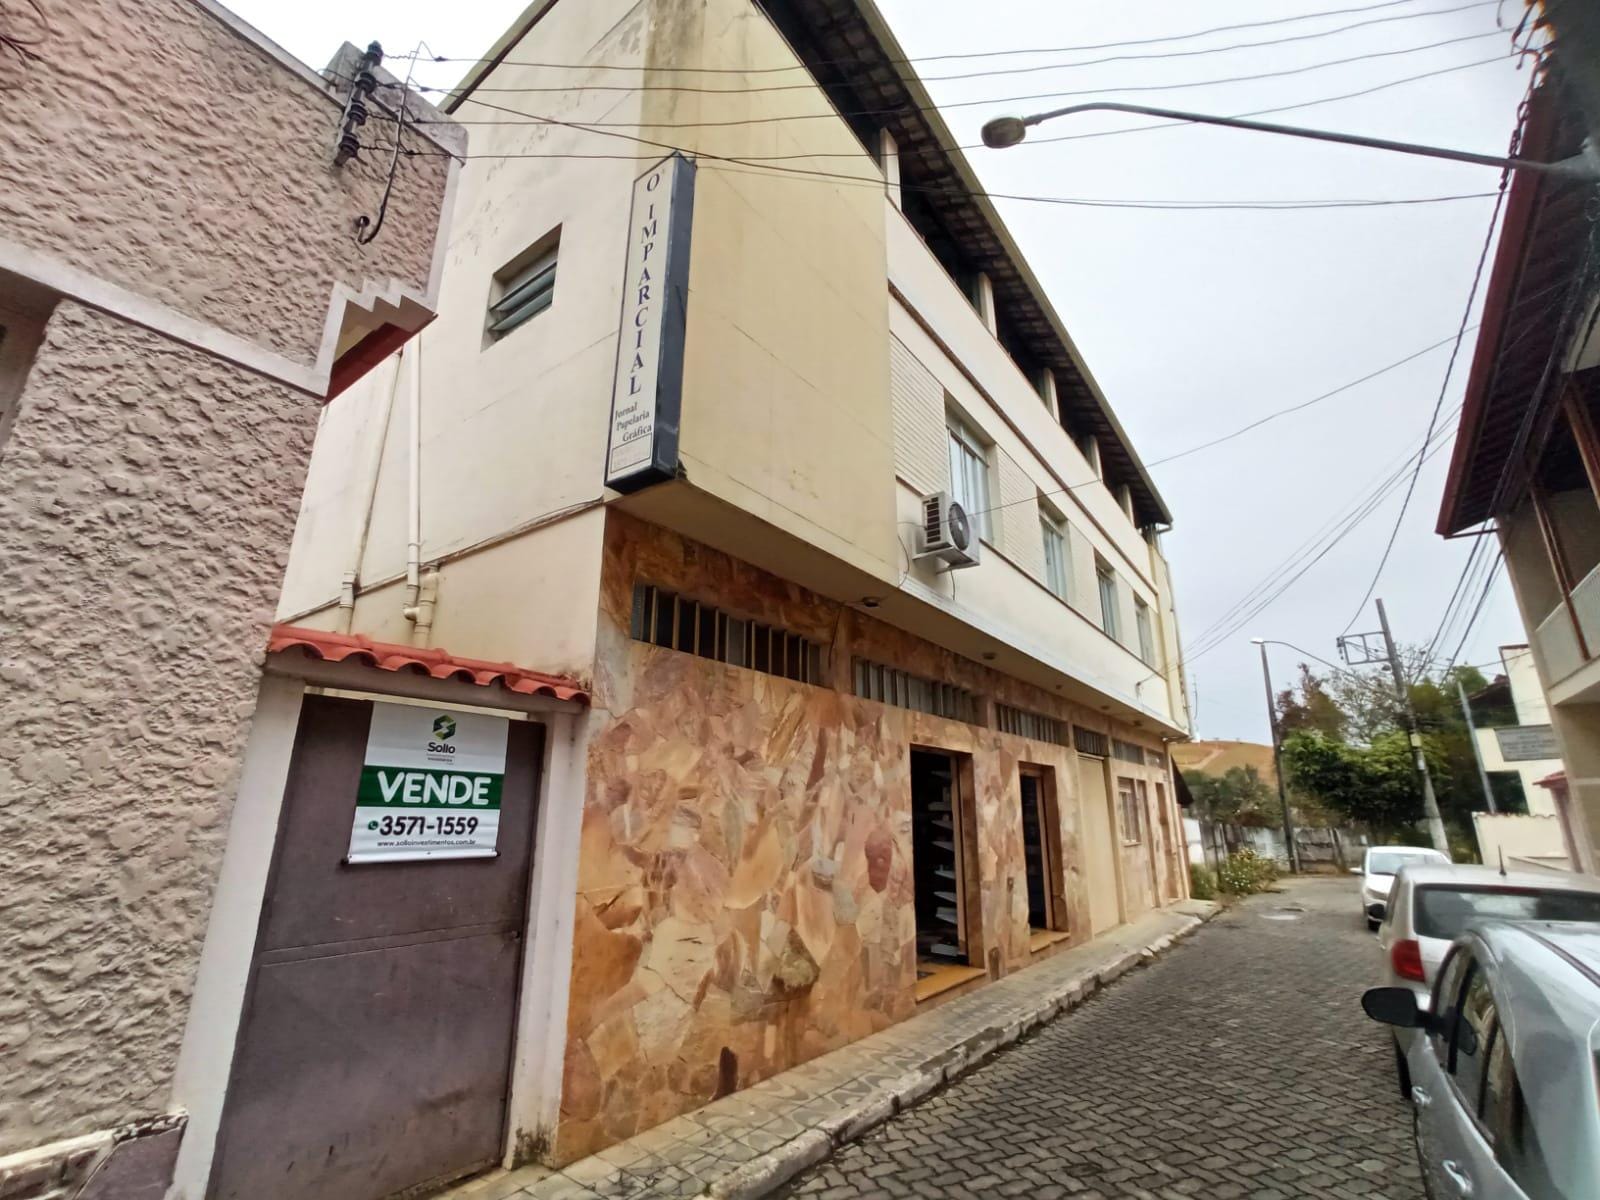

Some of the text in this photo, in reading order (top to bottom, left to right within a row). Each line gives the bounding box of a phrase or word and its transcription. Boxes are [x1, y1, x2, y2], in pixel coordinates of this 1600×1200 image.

[628, 173, 661, 396] O IMPARCIAL
[615, 402, 638, 420] Jornal
[616, 410, 650, 431] Papelaria
[622, 424, 652, 441] Gráfica
[427, 742, 456, 754] Sollo
[377, 770, 492, 805] VENDE
[379, 815, 479, 836] 3571-1559
[377, 839, 476, 847] www.solloinvestimentos.com.br
